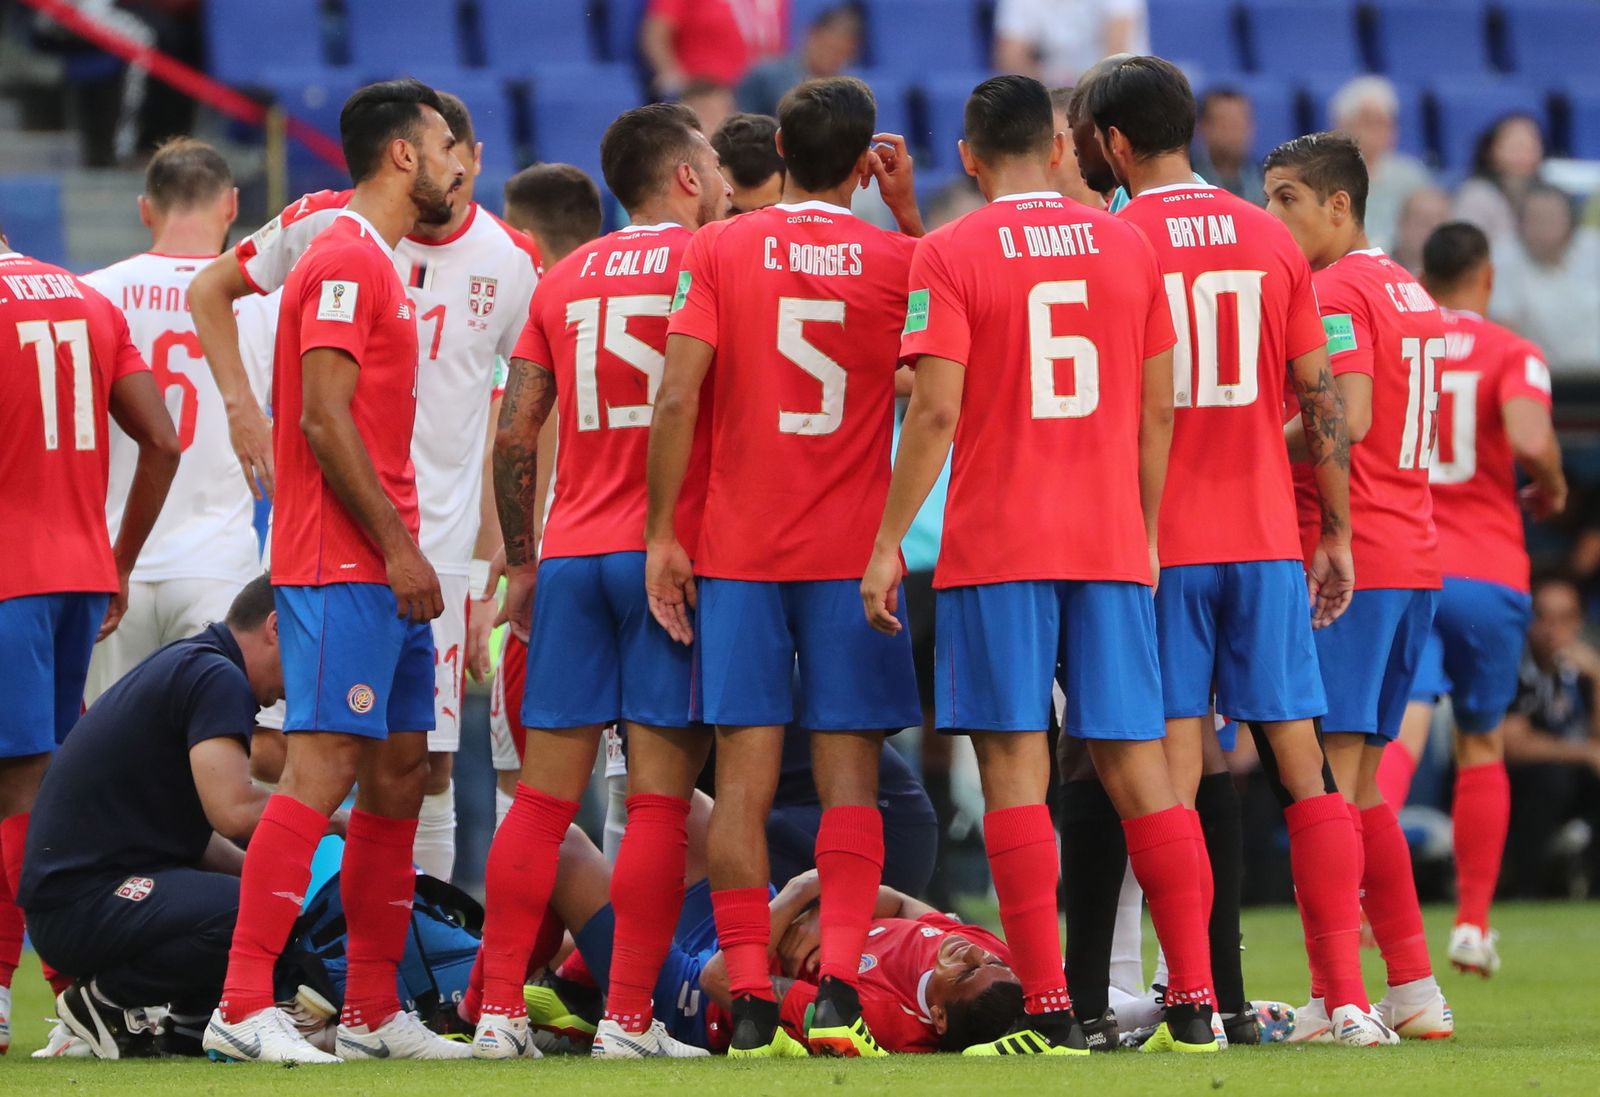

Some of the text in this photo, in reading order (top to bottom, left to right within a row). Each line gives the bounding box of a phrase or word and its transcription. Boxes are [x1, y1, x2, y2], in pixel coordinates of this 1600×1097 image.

[1016, 200, 1063, 210] COSTA RICA
[1163, 194, 1192, 203] COSTA
[786, 215, 833, 224] COSTA RICA
[1165, 214, 1237, 248] BRYAN
[764, 236, 862, 276] C. BORGES
[998, 222, 1099, 259] O. DUARTE
[580, 246, 670, 278] F. CALVO
[1028, 279, 1099, 420] 6
[1164, 269, 1268, 409] 10
[566, 295, 671, 432] 15
[777, 296, 846, 435] 5
[15, 318, 96, 451] 11
[150, 329, 206, 454] 6
